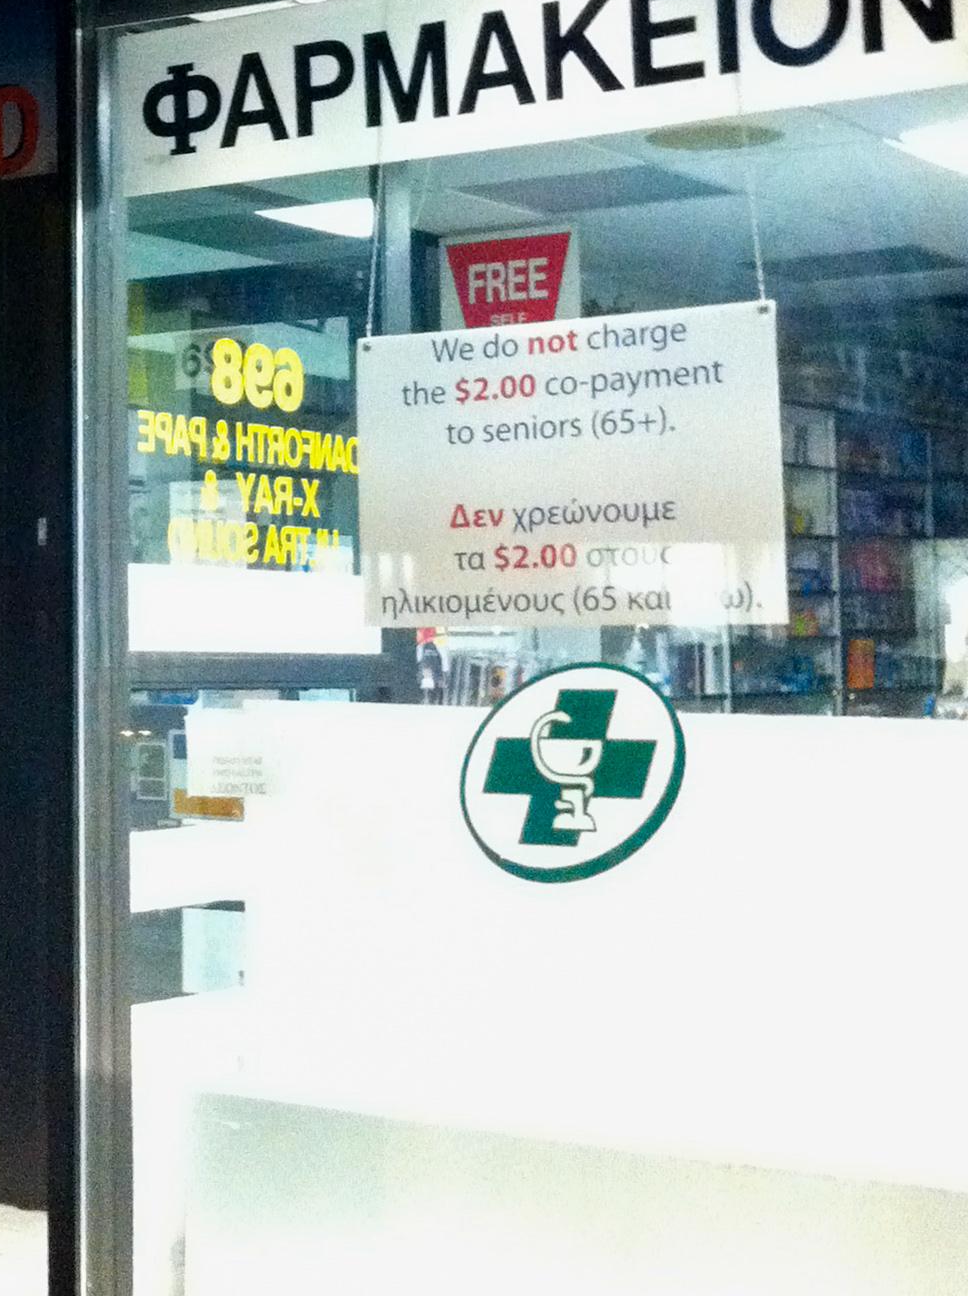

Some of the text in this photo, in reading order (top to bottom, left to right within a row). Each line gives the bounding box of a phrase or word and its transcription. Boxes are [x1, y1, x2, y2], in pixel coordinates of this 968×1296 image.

[468, 258, 550, 304] FREE
[432, 320, 687, 362] We do not charge
[402, 359, 724, 406] the $2.00 co-payment
[446, 405, 676, 445] to seniors (65+).
[450, 499, 677, 533] Δεν χρεώνουμε
[454, 551, 485, 571] τα
[493, 543, 578, 573] $2.00
[573, 583, 617, 615] (65
